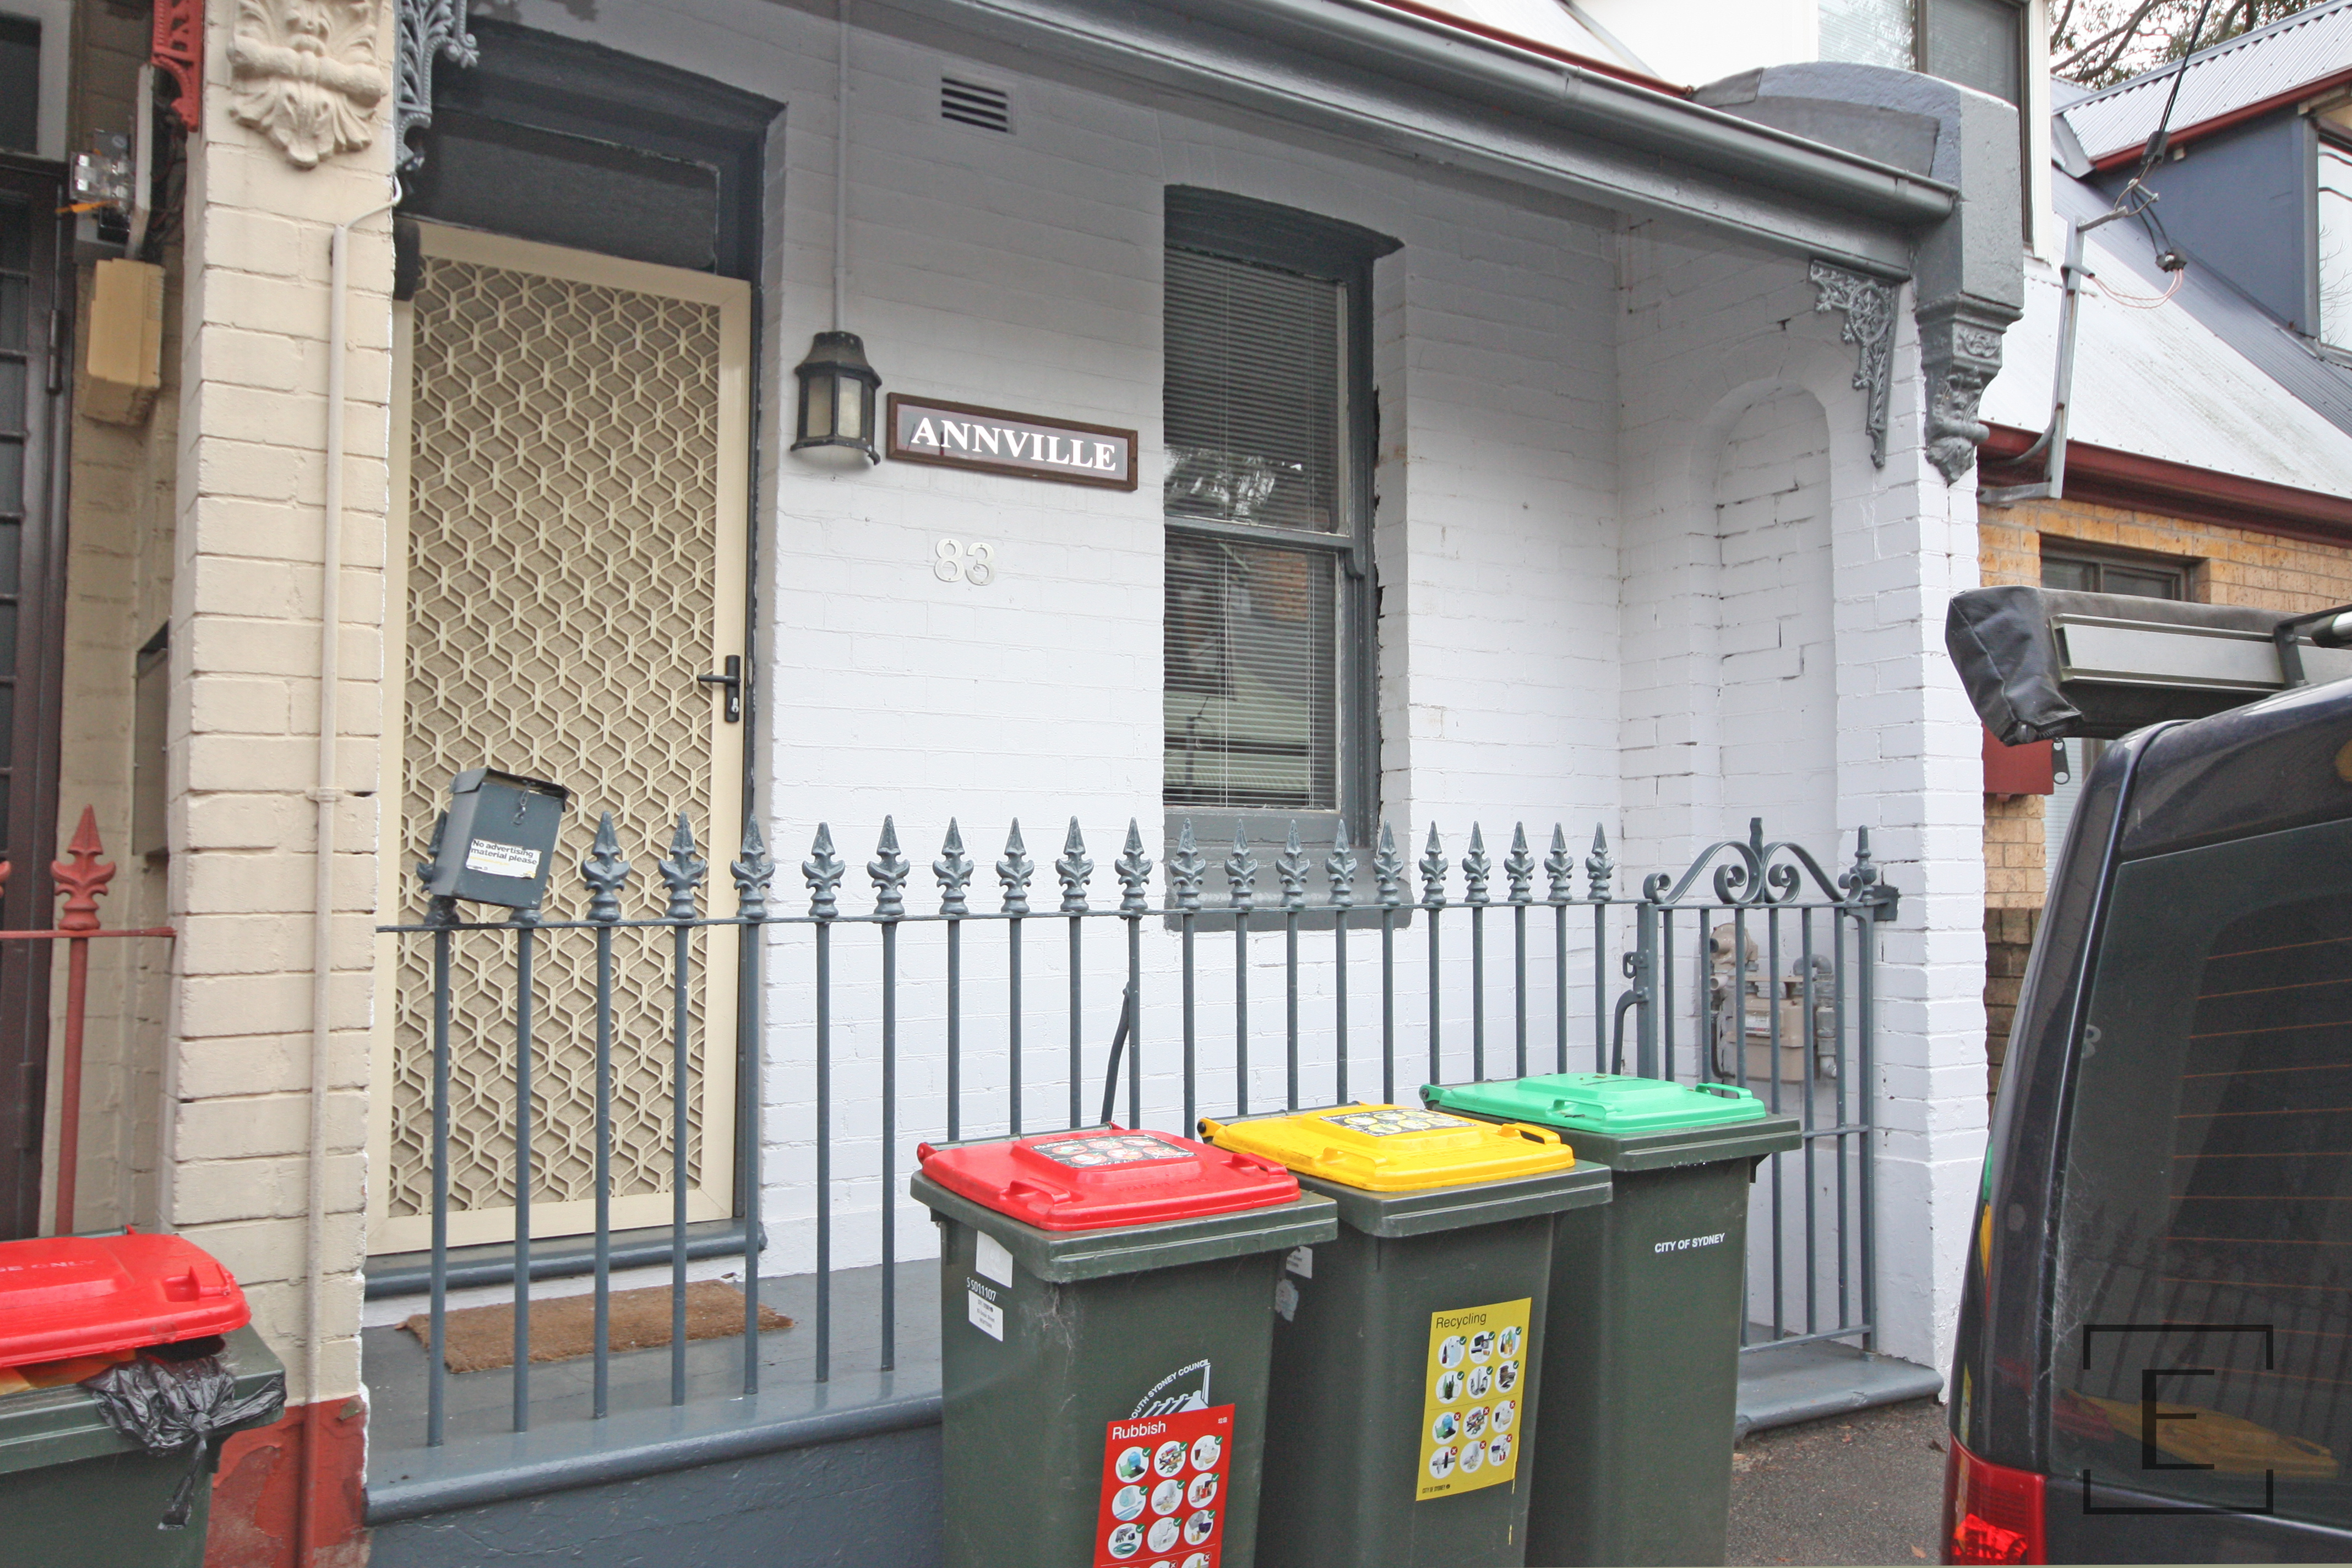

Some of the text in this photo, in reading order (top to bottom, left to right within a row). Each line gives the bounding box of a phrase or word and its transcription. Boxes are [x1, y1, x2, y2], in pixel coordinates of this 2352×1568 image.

[911, 417, 1117, 471] ANNVILLE
[934, 538, 995, 586] 83
[471, 847, 507, 859] material
[508, 854, 537, 865] please
[486, 843, 534, 858] advertising
[1654, 1232, 1725, 1253] CITY OF SYDNEY
[1436, 1313, 1487, 1329] Recycling
[1128, 1358, 1211, 1420] OUTH SYDNEY COUNCIL
[1112, 1421, 1166, 1440] Rubbish
